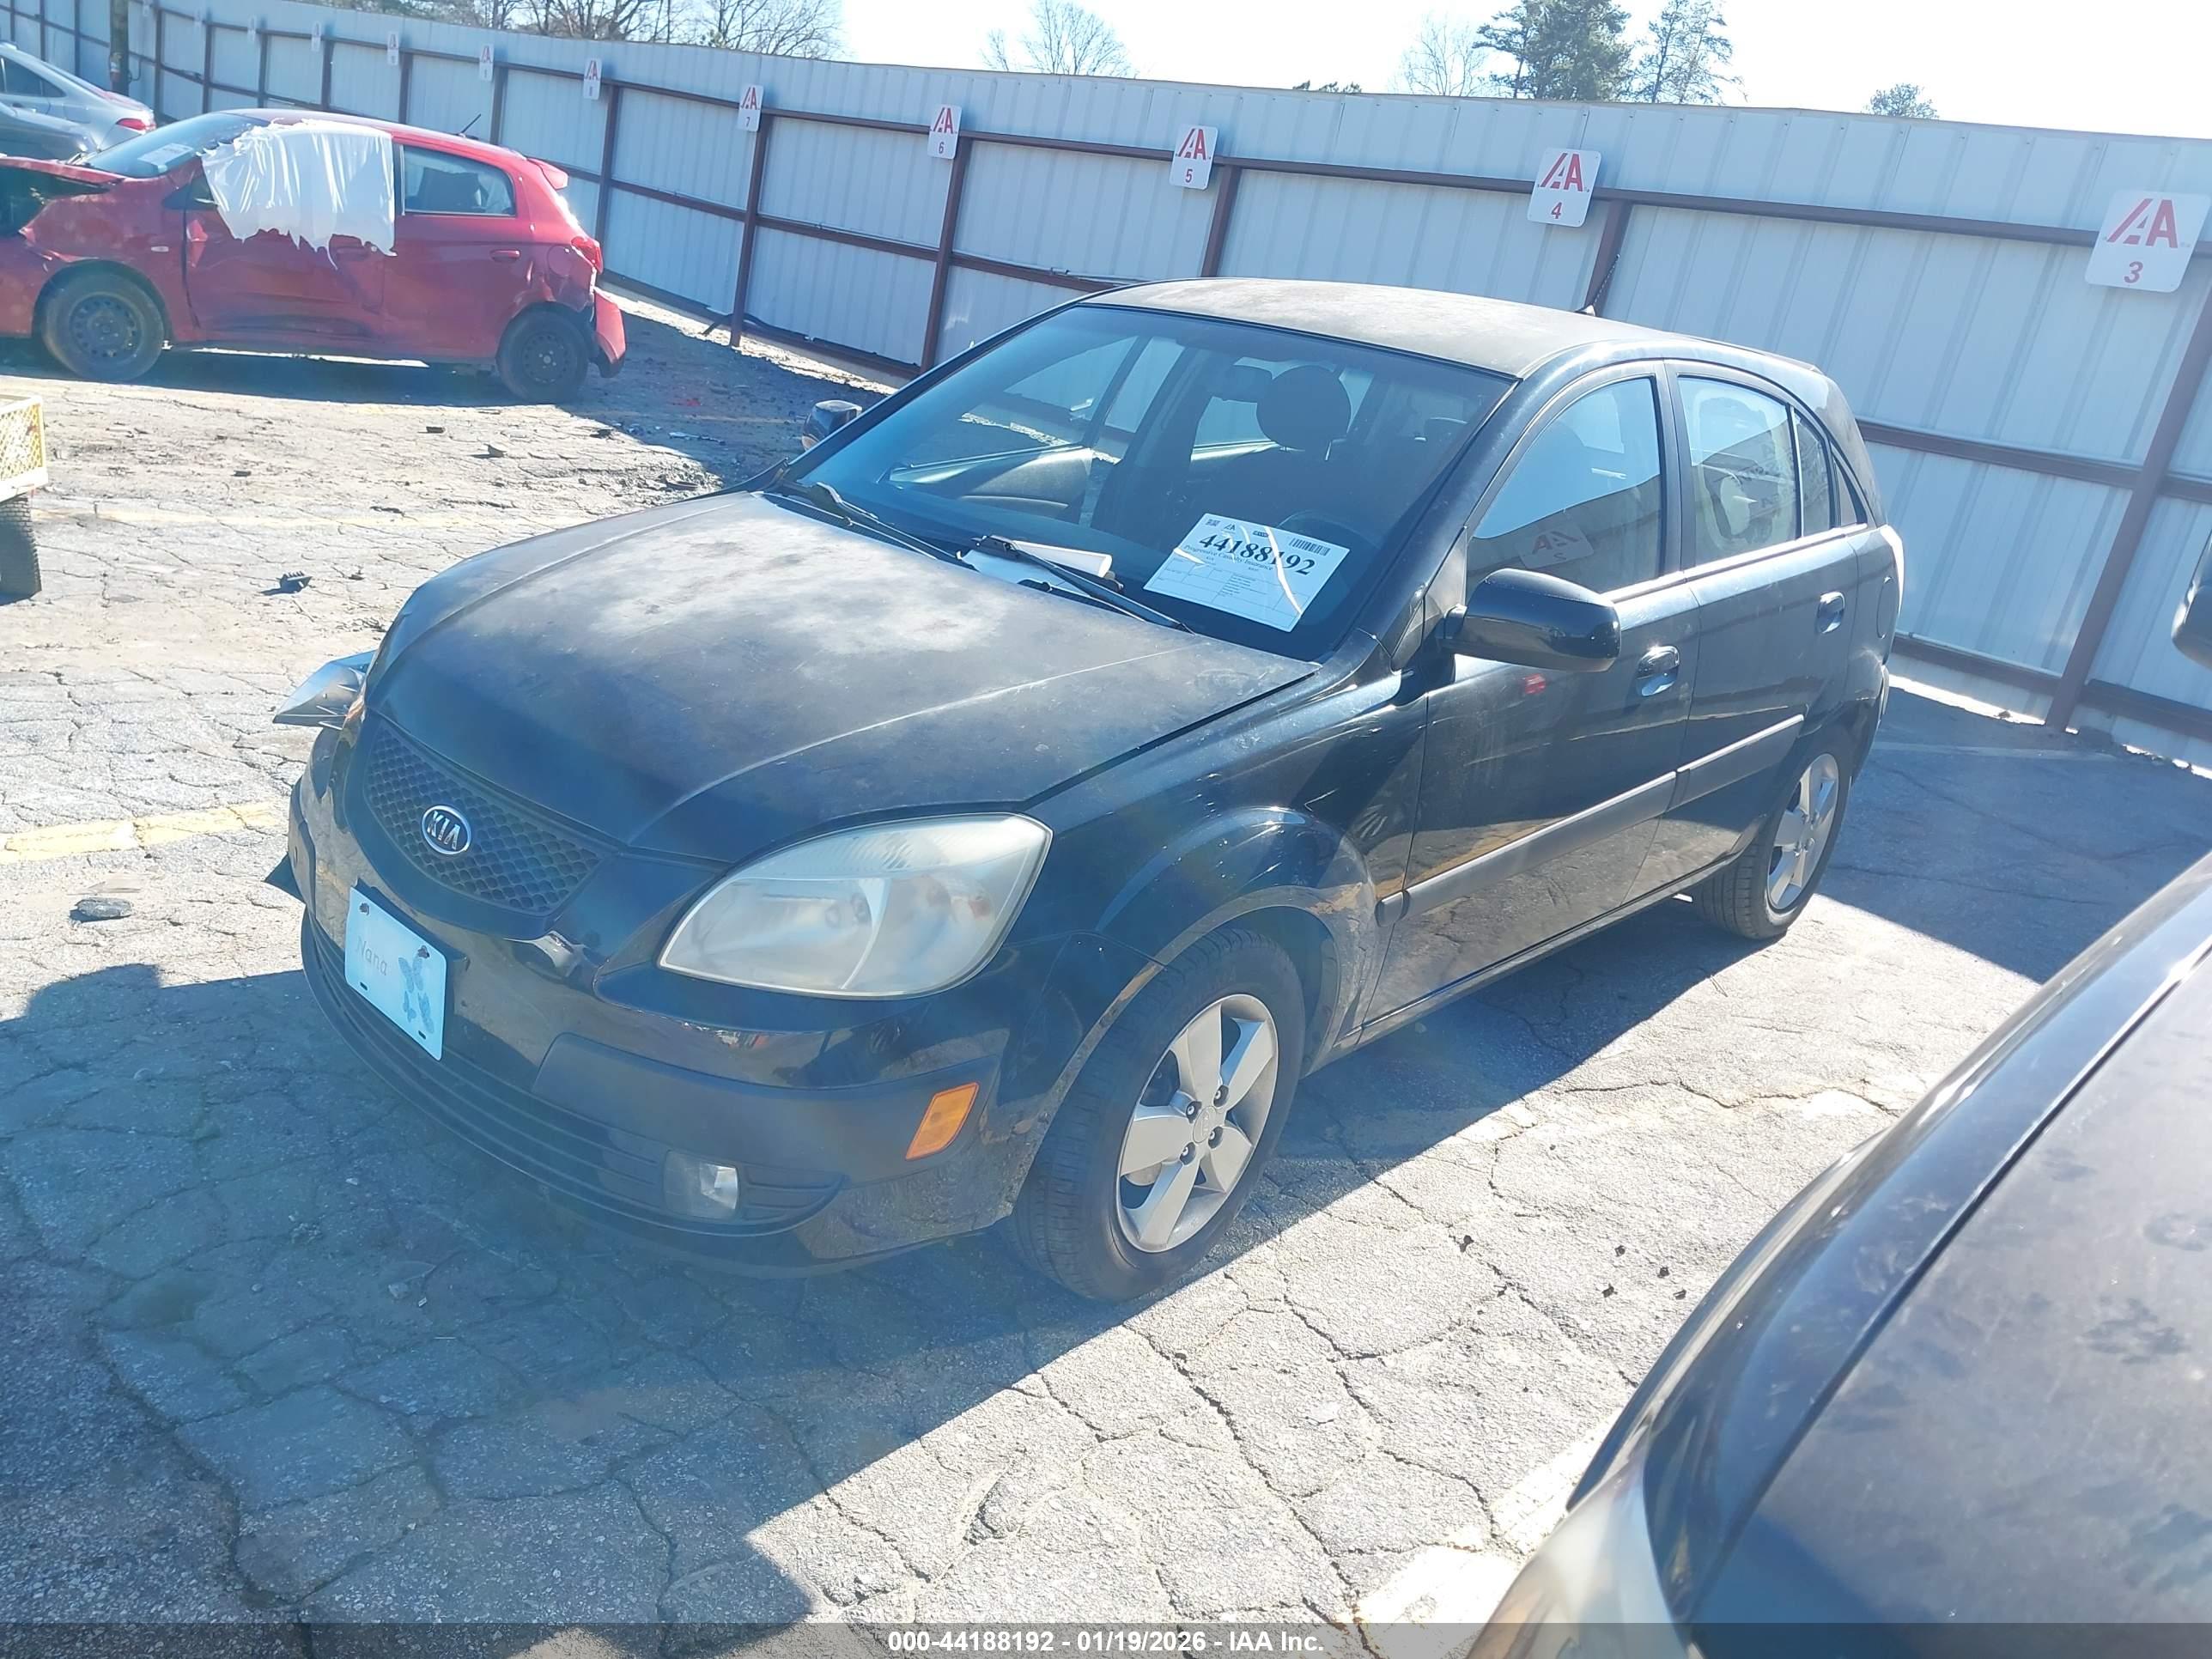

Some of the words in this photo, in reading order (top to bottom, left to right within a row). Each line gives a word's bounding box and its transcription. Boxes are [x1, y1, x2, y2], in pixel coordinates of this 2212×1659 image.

[746, 116, 750, 128] 7
[939, 142, 945, 155] 6
[1185, 168, 1194, 183] 5
[1551, 202, 1563, 220] 4
[2124, 261, 2143, 284] 3
[1199, 534, 1316, 575] 44188192
[426, 810, 461, 851] KIA
[356, 935, 387, 976] Nana
